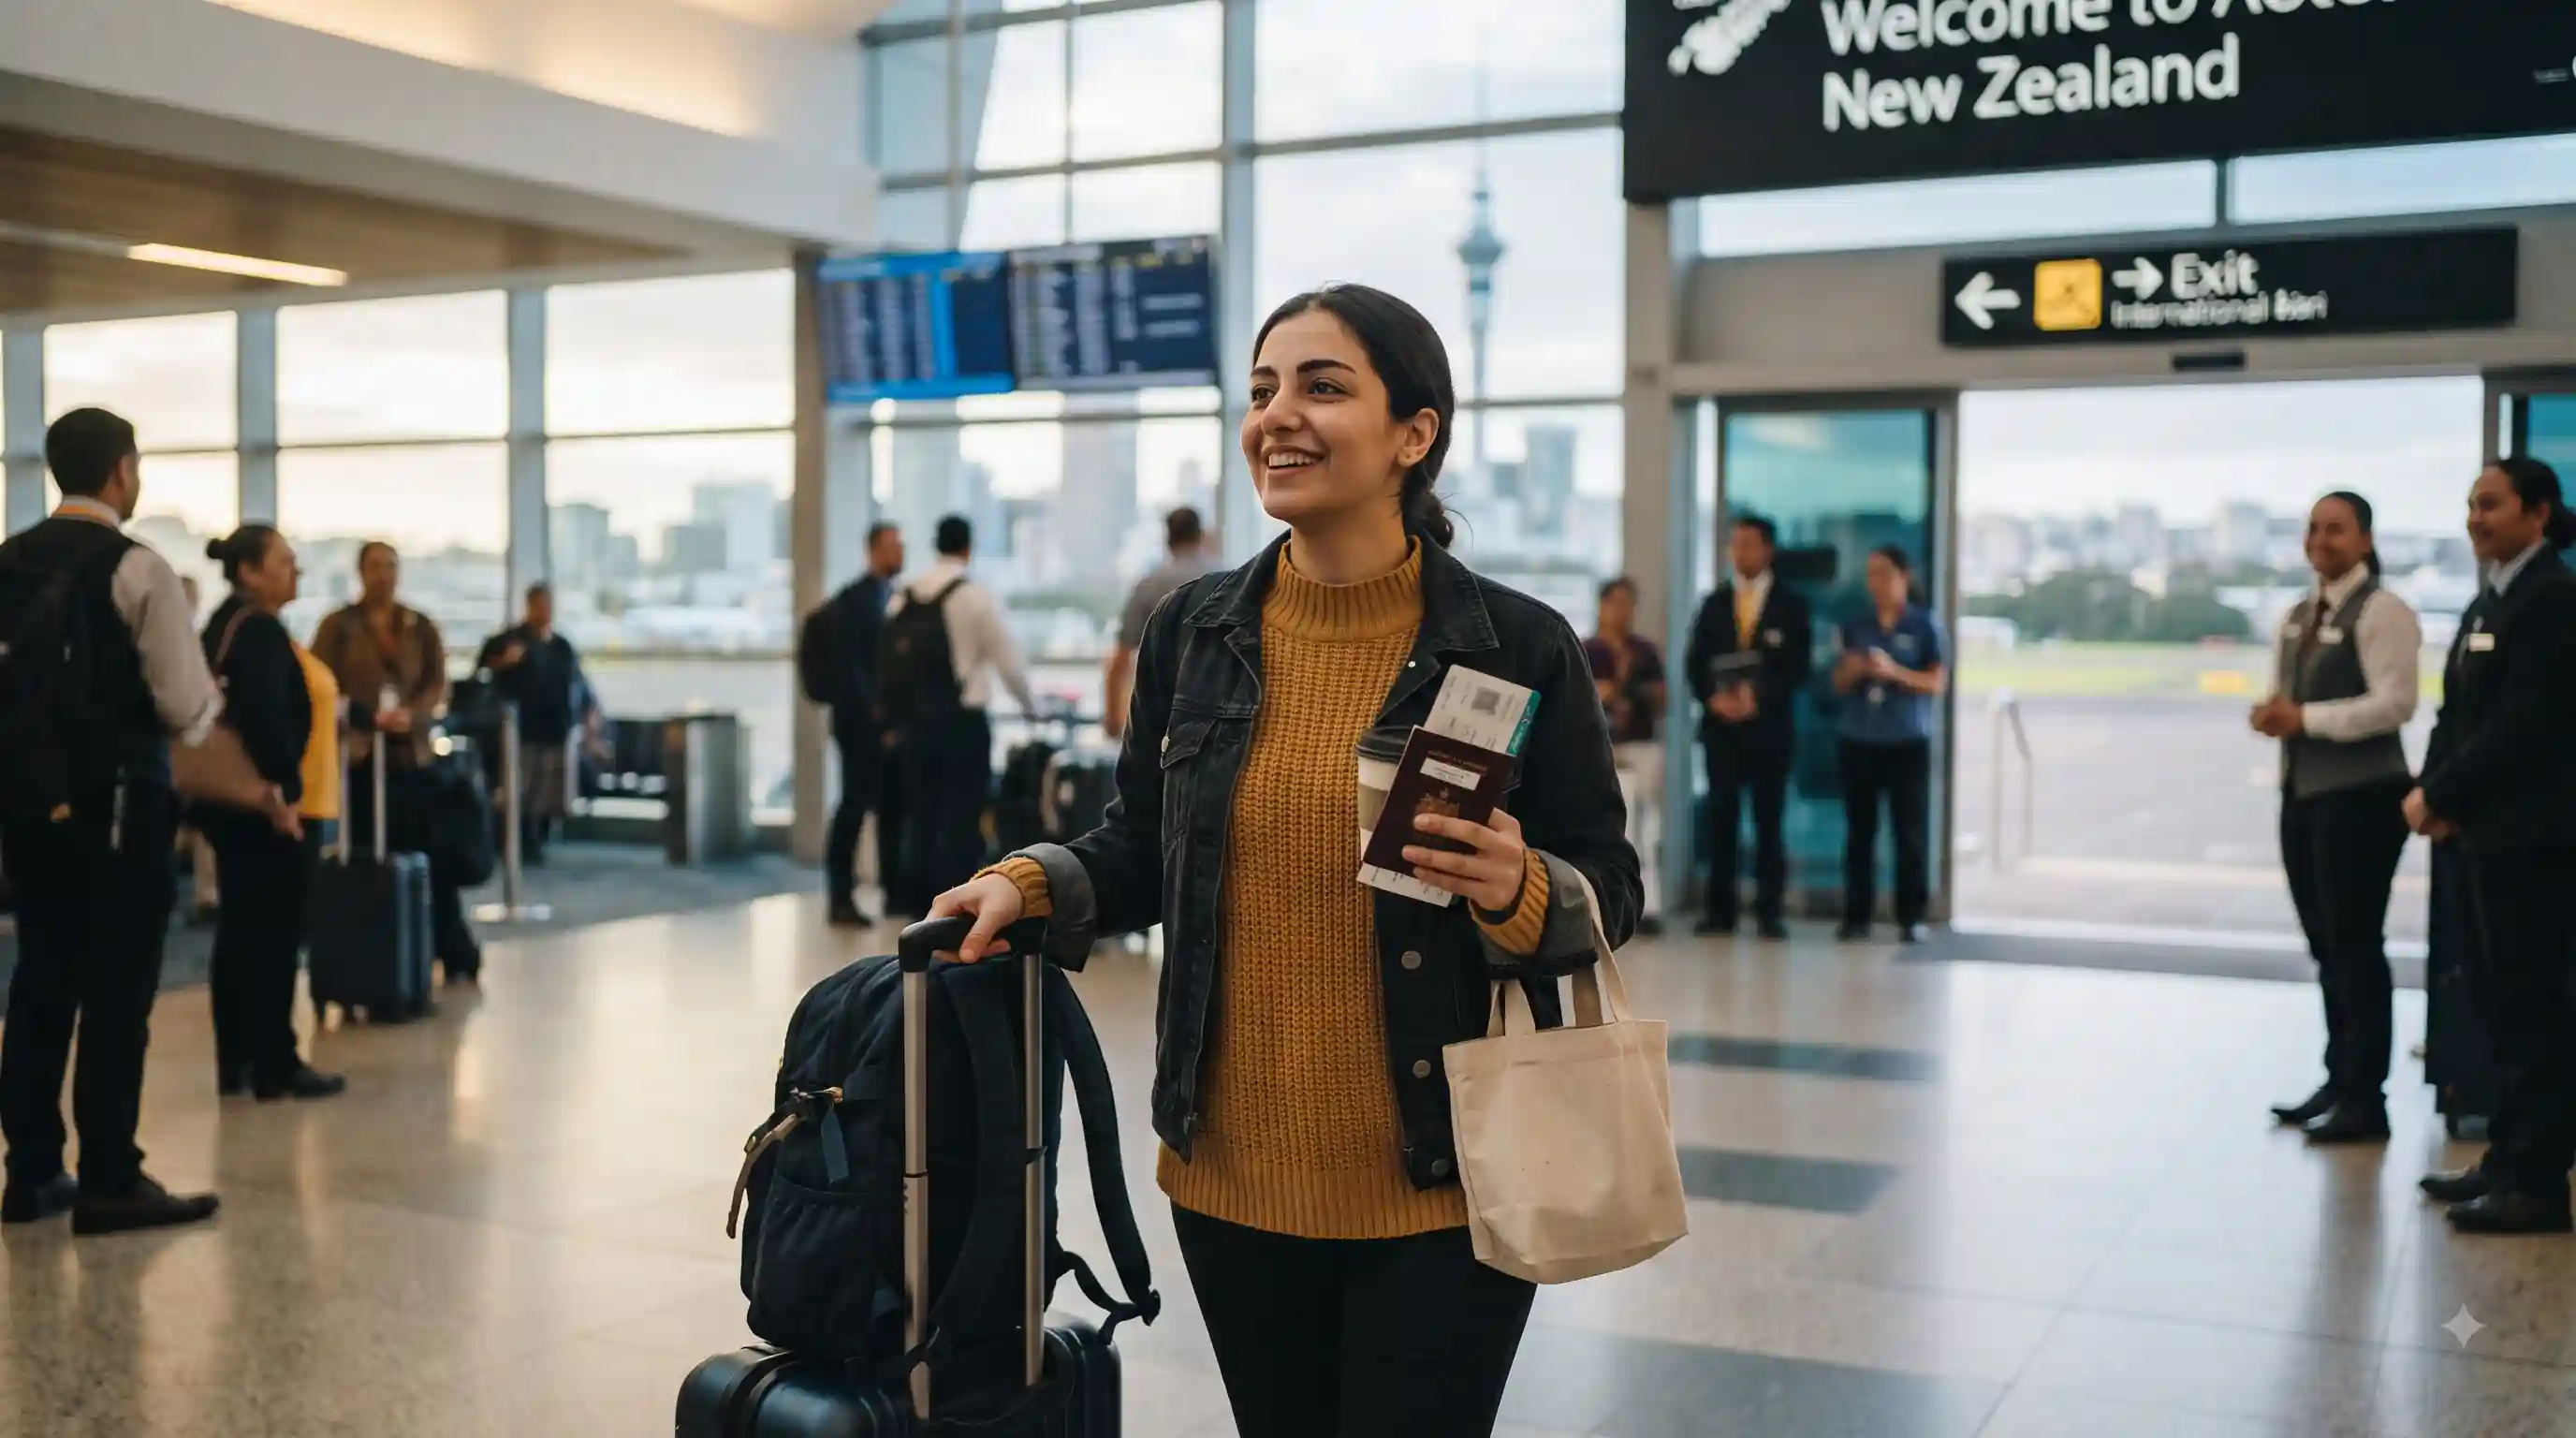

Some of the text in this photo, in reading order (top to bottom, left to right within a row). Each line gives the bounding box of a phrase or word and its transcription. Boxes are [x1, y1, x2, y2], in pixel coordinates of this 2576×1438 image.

[1820, 0, 2113, 55] Welcome
[1822, 32, 2240, 132] New Zealand
[2170, 248, 2261, 299] Exit
